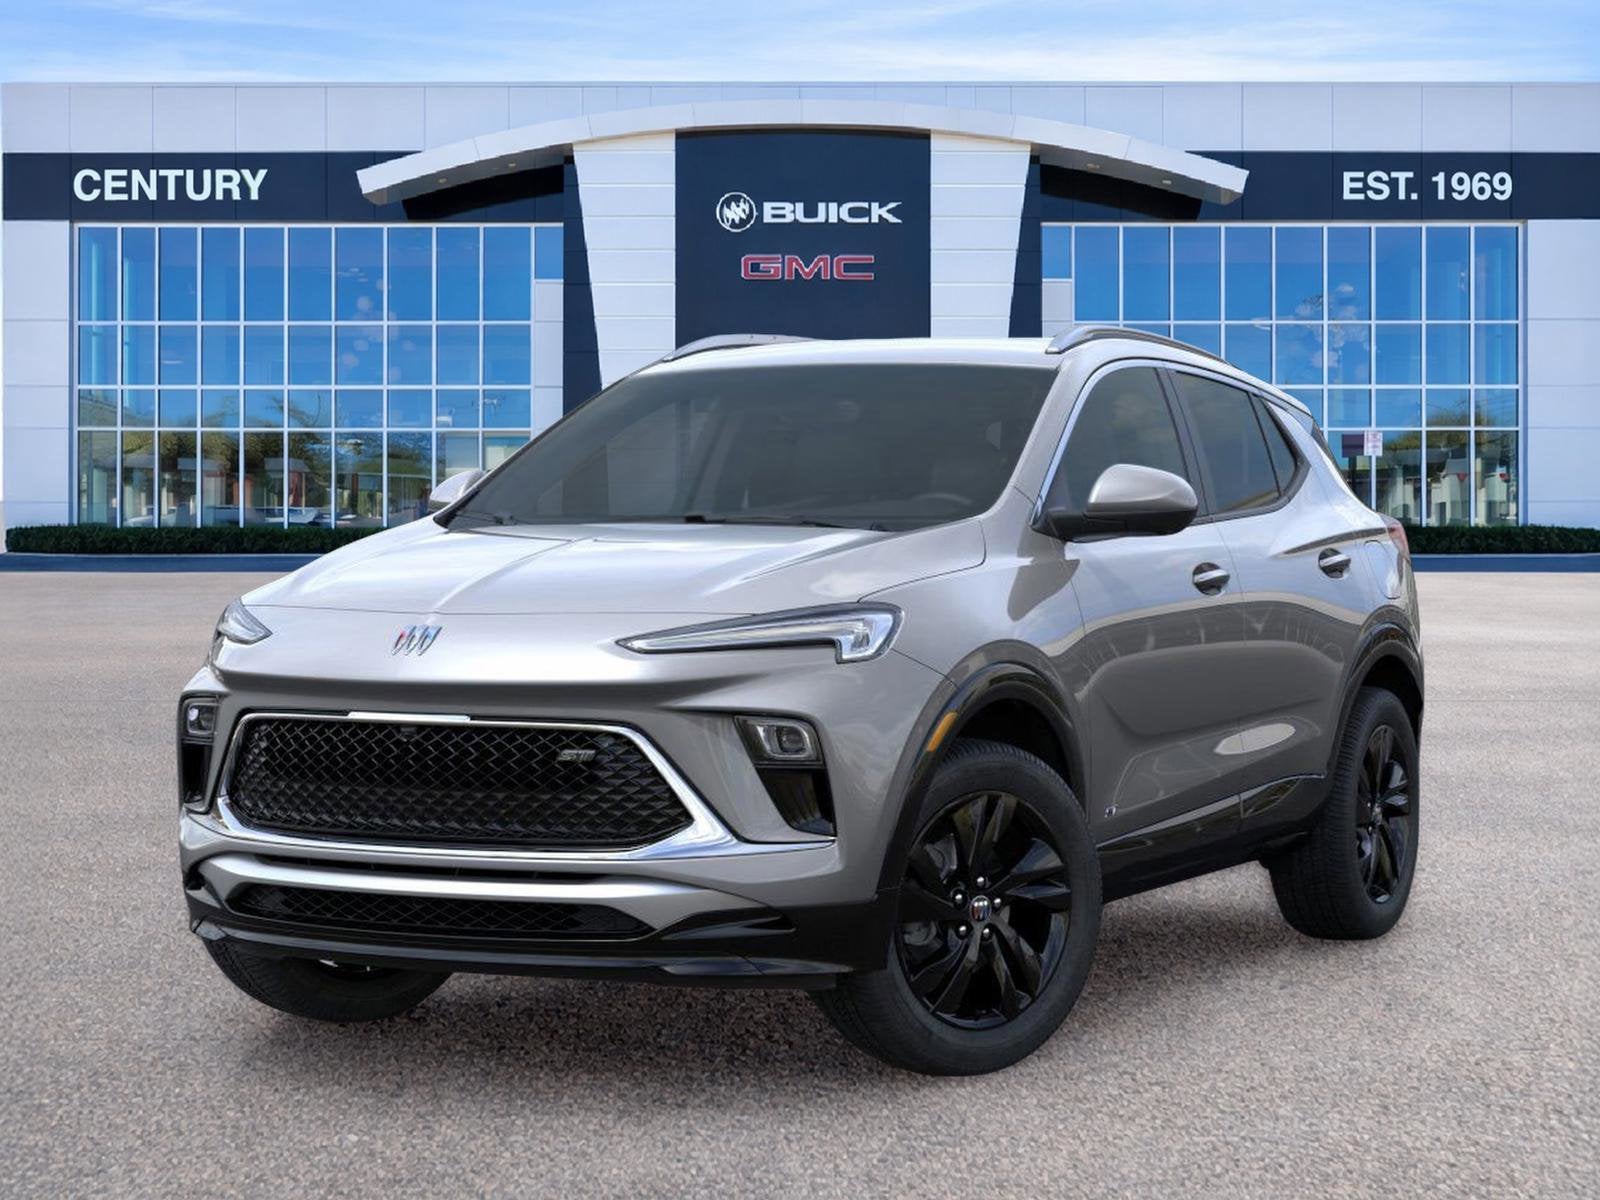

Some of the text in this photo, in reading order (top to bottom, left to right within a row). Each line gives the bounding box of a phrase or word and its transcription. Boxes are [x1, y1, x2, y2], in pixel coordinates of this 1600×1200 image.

[73, 168, 268, 201] CENTURY
[1343, 171, 1513, 201] EST. 1969
[763, 202, 902, 223] BUICK
[741, 254, 874, 280] GMC
